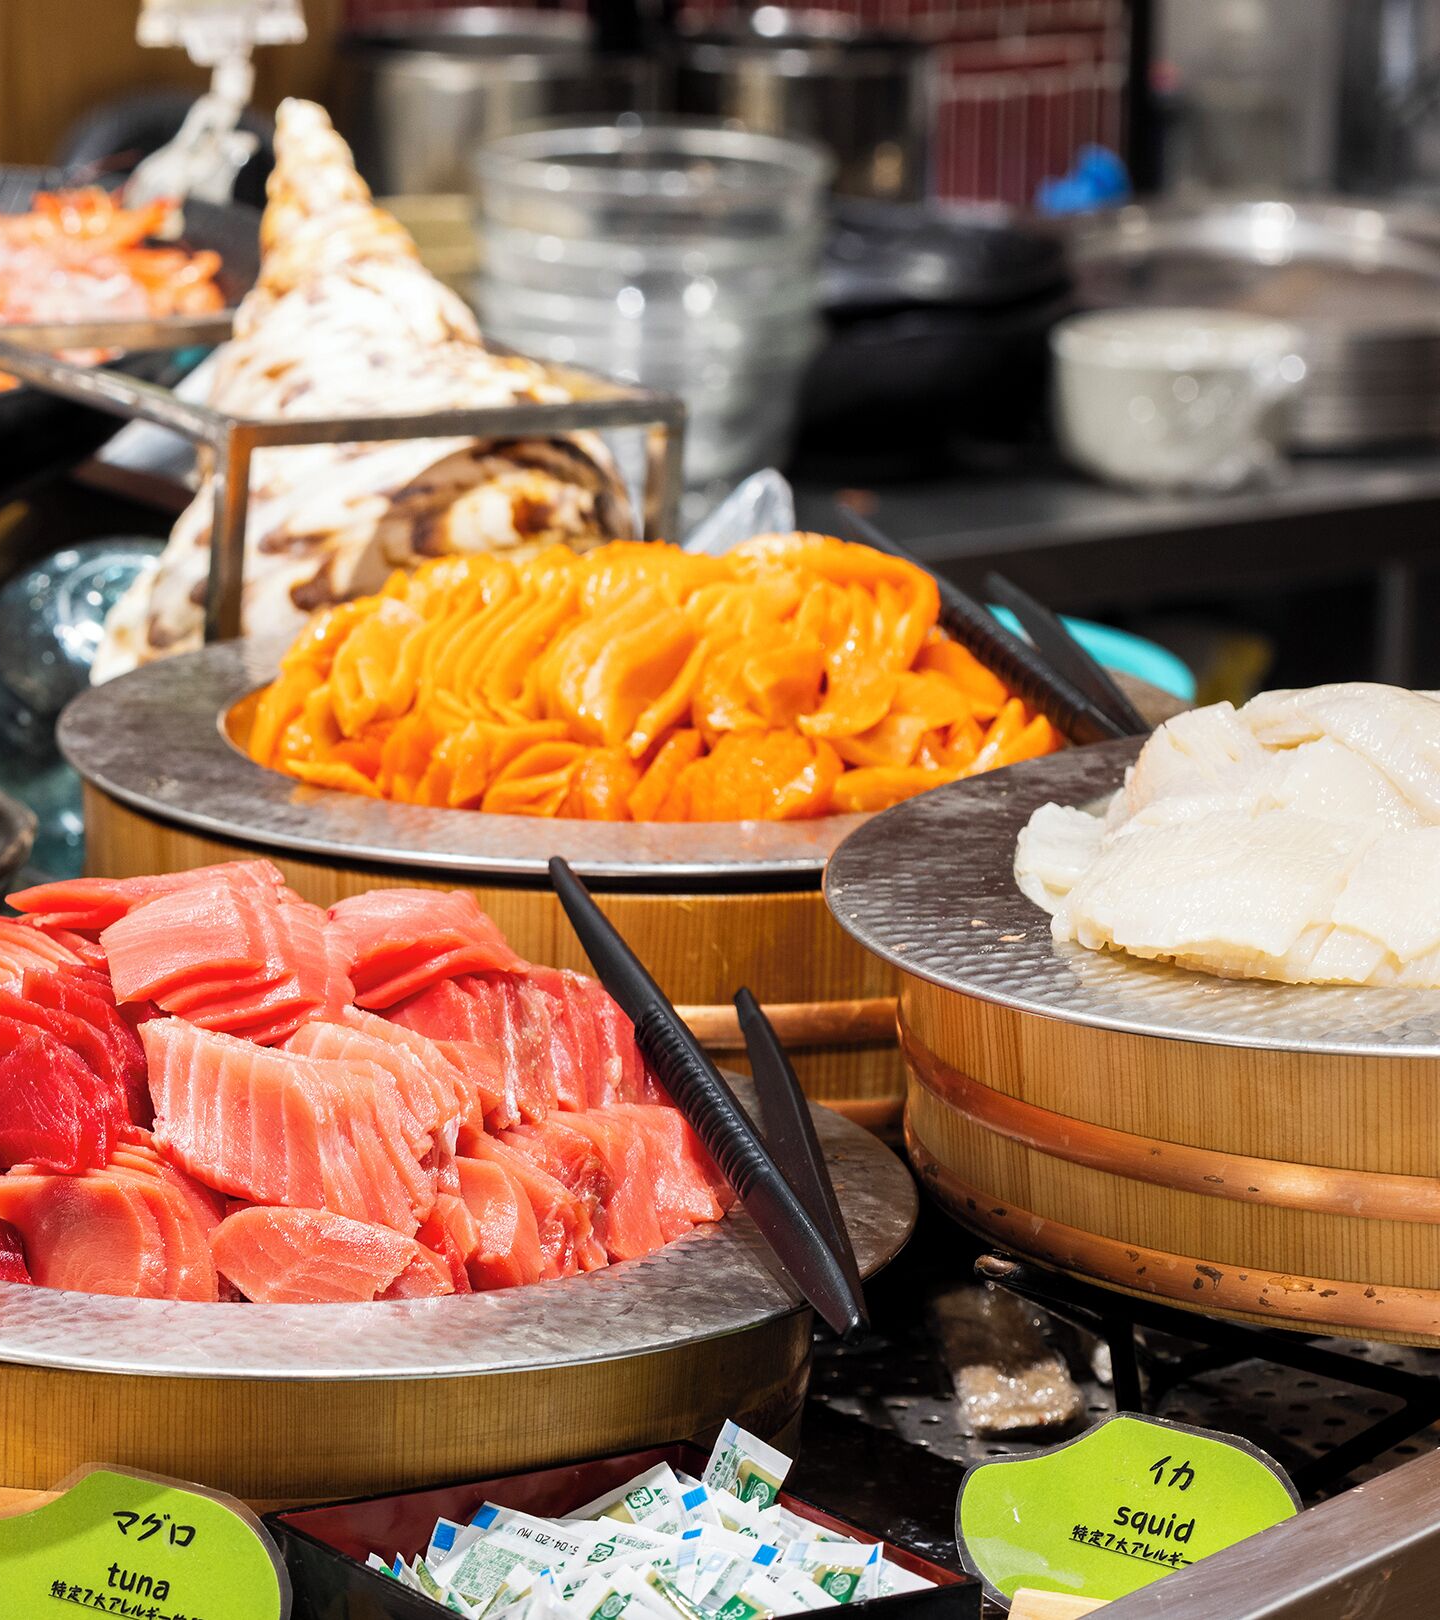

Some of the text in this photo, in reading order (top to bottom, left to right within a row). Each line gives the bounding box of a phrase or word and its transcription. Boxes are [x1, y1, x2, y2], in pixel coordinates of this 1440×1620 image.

[1149, 1455, 1195, 1491] イカ
[112, 1511, 196, 1547] マグロ
[1113, 1506, 1196, 1544] squid
[107, 1562, 170, 1601] tuna
